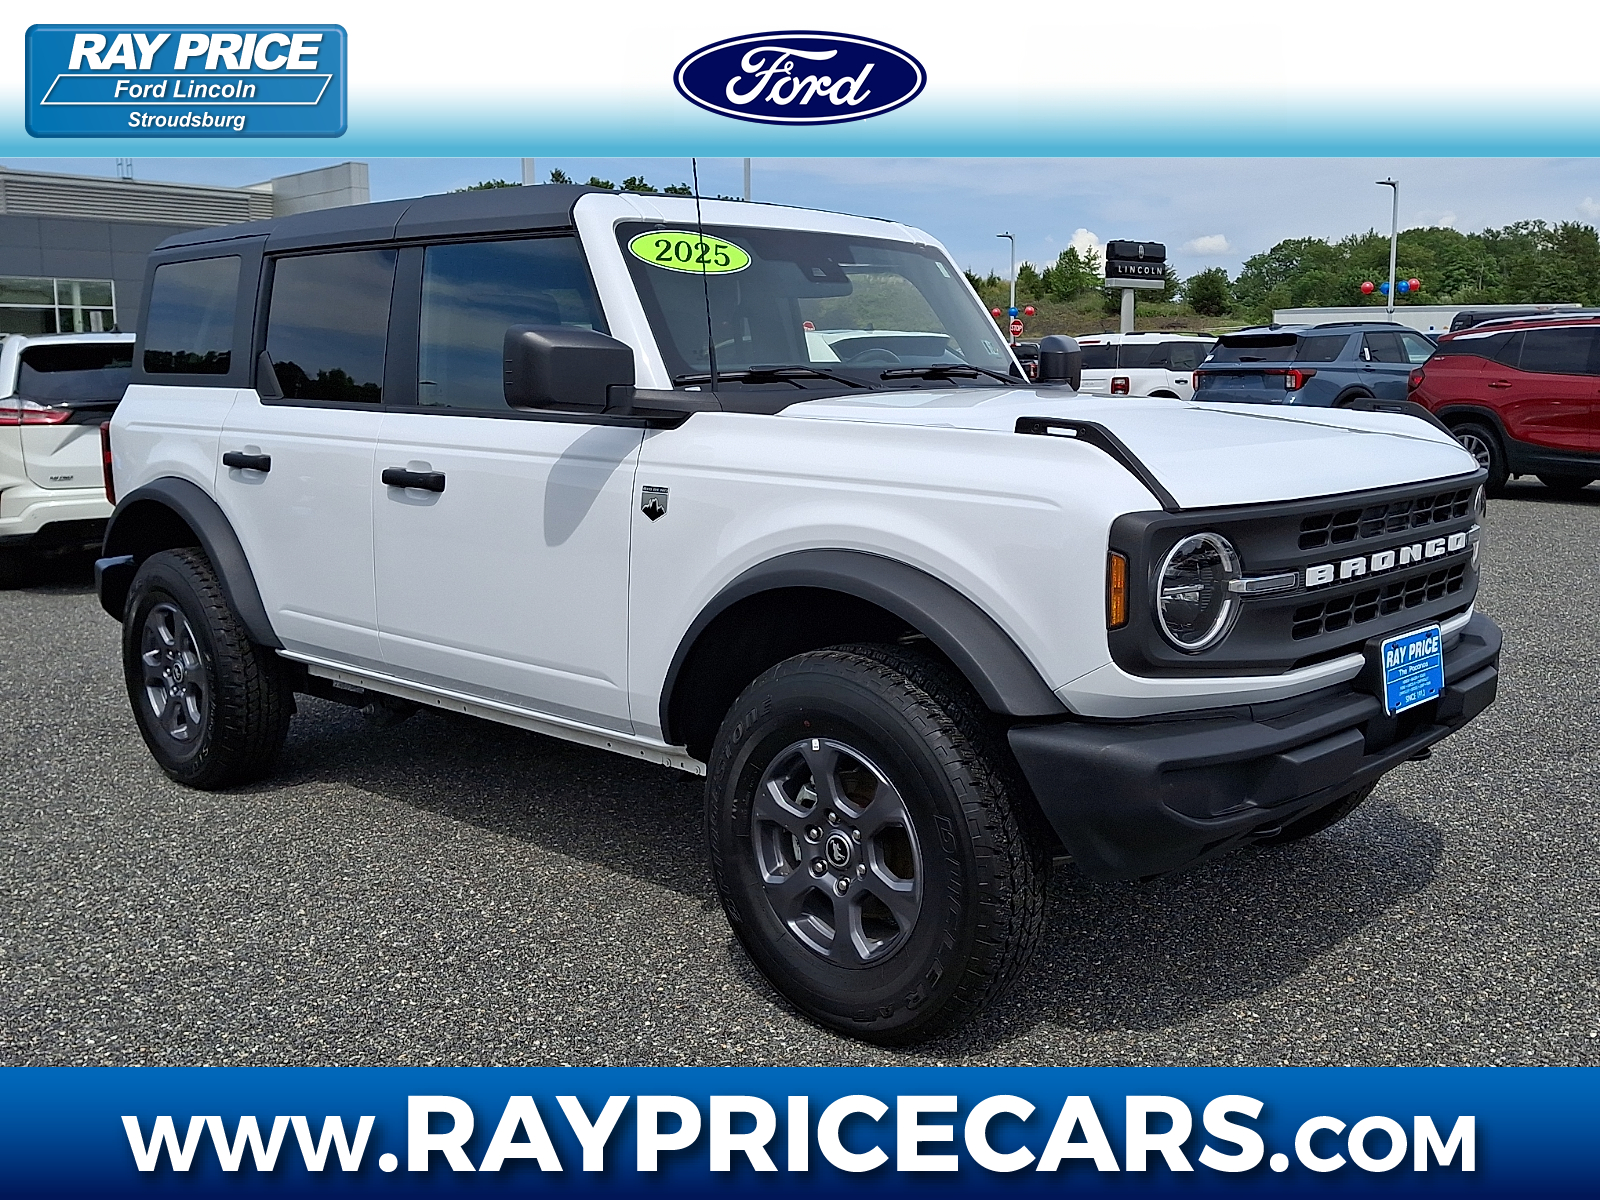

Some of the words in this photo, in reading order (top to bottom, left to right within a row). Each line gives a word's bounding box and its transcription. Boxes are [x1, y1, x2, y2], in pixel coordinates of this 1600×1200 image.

[654, 239, 731, 266] 2025
[1118, 265, 1163, 275] LINCOLN
[1010, 324, 1023, 332] STOP
[1305, 532, 1466, 587] BRONCO
[1386, 646, 1406, 668] RAY
[1409, 636, 1439, 660] PRICE
